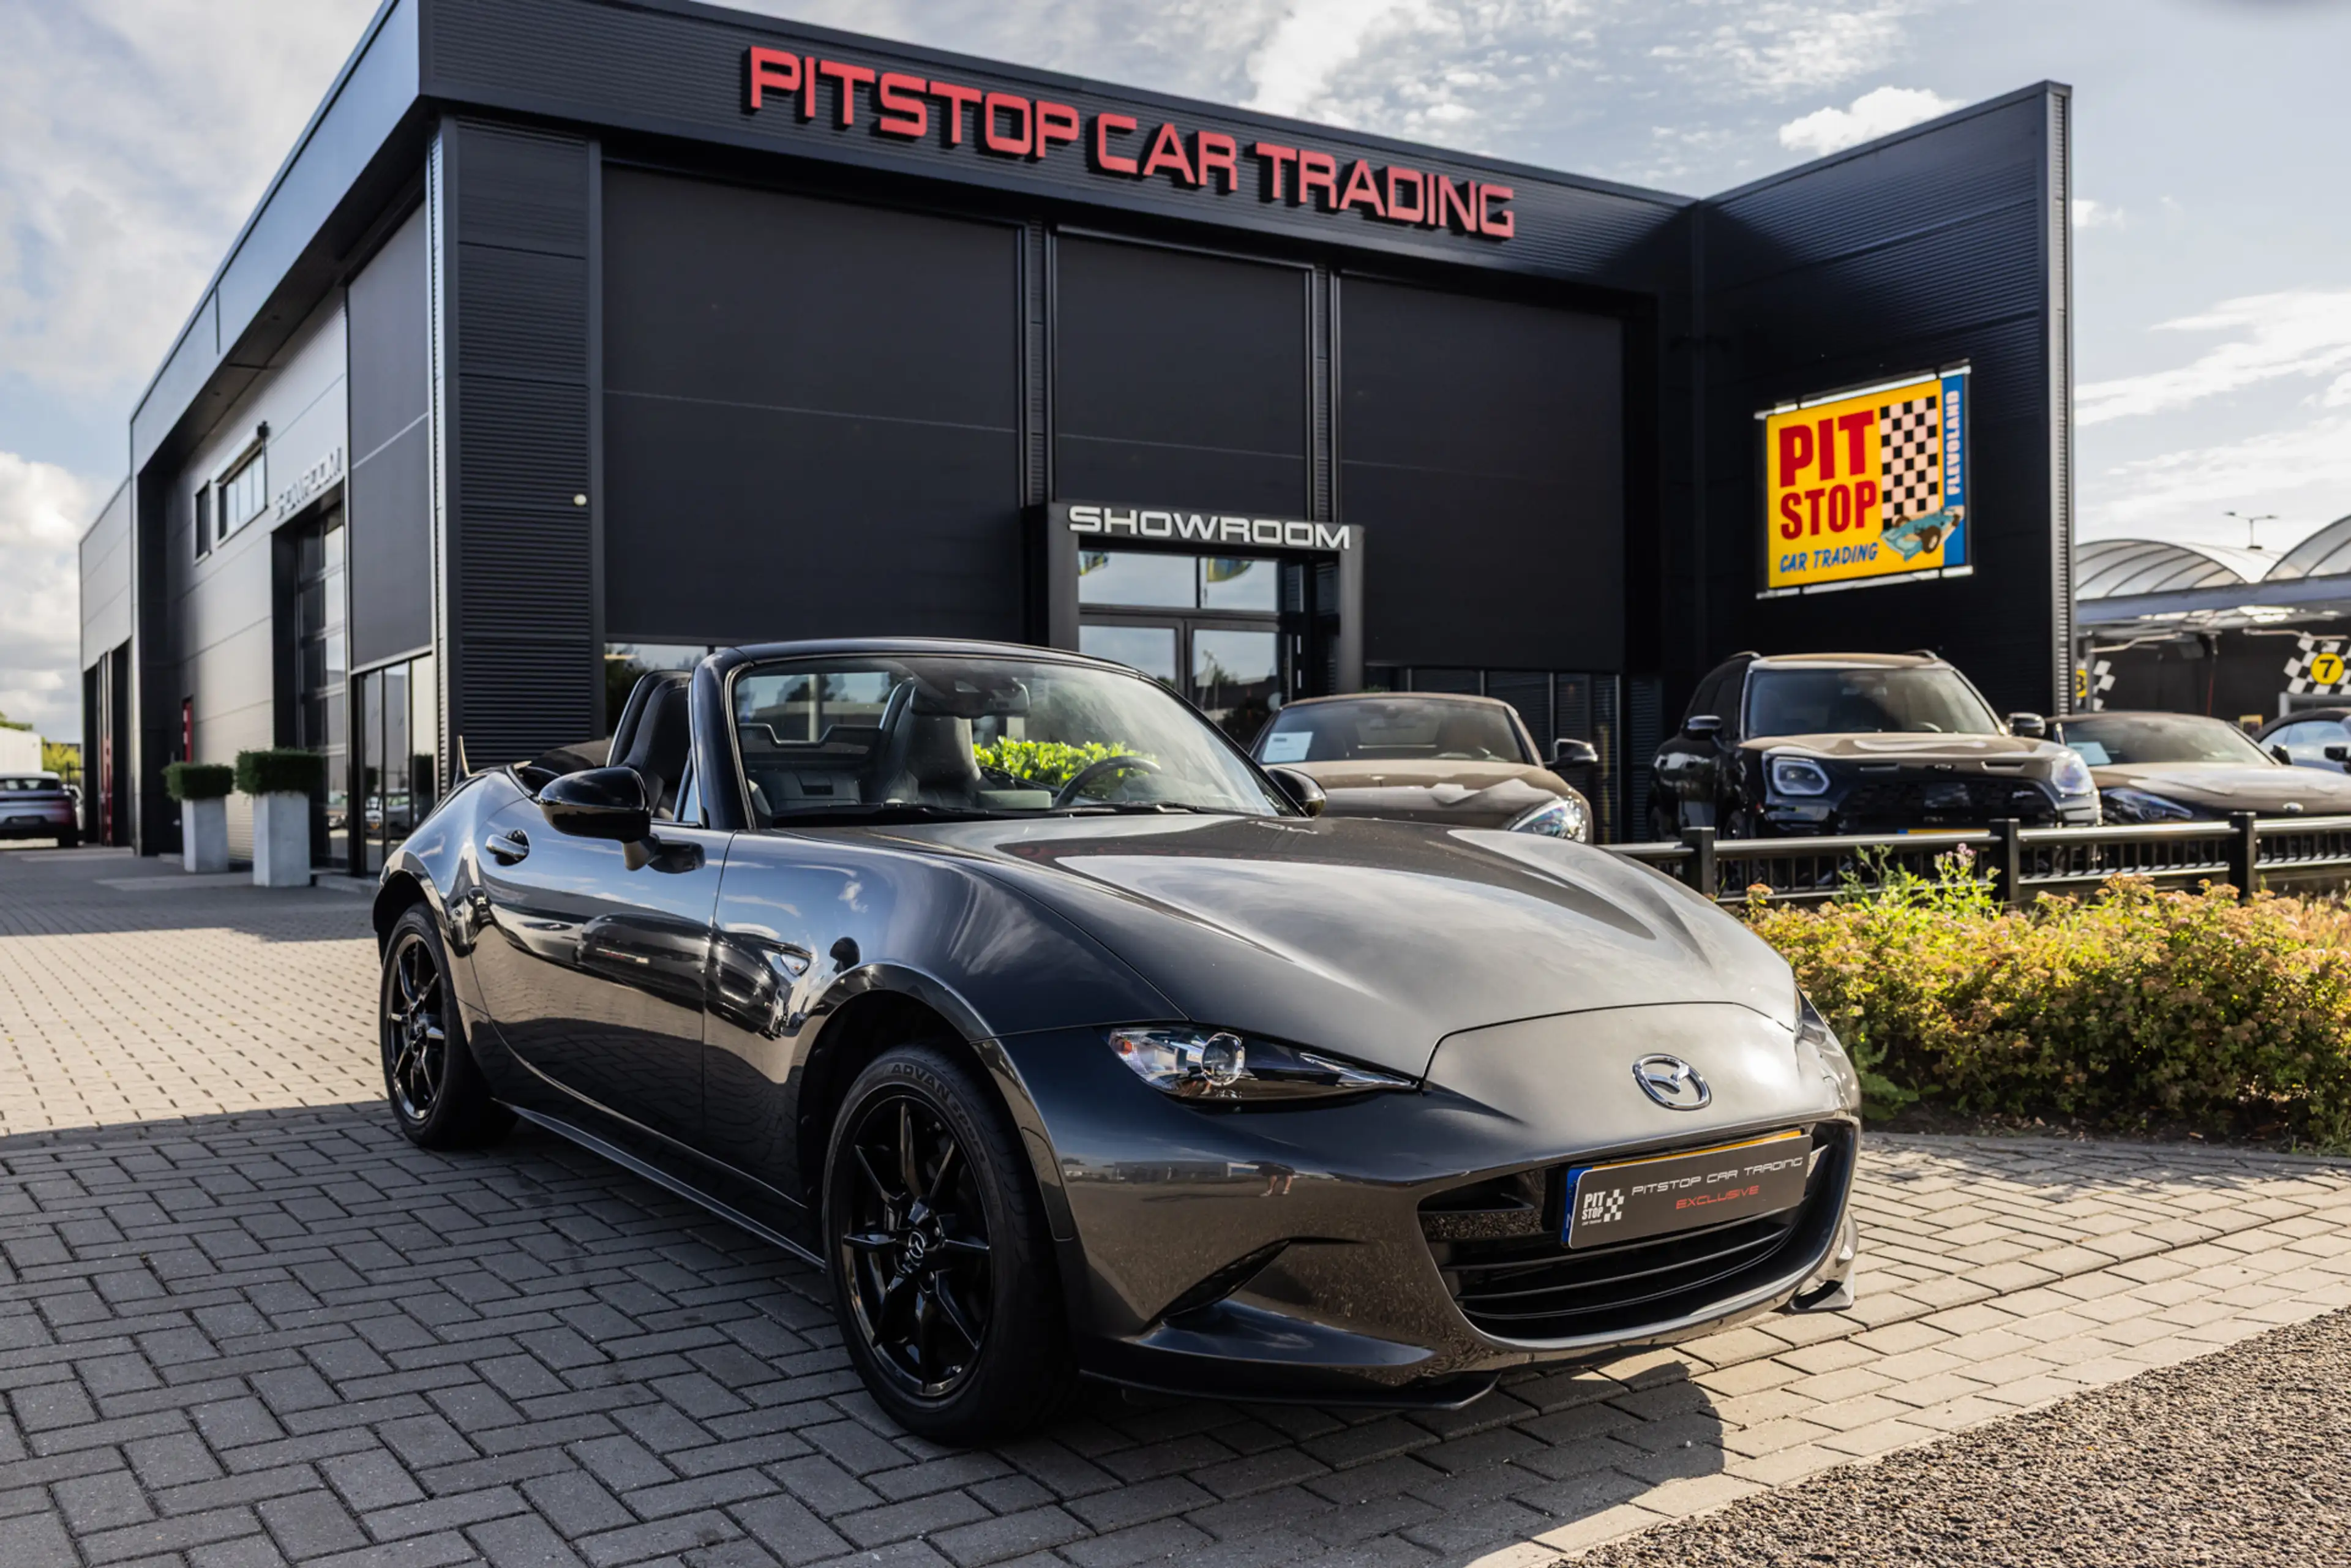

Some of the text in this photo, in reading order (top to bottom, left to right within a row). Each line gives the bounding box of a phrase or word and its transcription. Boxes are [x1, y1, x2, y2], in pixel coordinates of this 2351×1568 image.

[749, 45, 1514, 238] PITSTOP CAR TRADING
[1779, 409, 1875, 488] PIT
[1944, 389, 1962, 496] FLEVOLAND
[1068, 505, 1351, 550] SHOWROOM
[1780, 480, 1878, 541] STOP
[1780, 542, 1878, 573] CAR TRADING
[2319, 658, 2336, 678] 7
[890, 1063, 951, 1101] ADVAN
[1631, 1157, 1804, 1196] PITSTOP CAR TRADING
[1581, 1206, 1604, 1220] STOP
[1583, 1191, 1607, 1209] PIT
[1675, 1185, 1760, 1210] EXCLUSIVE
